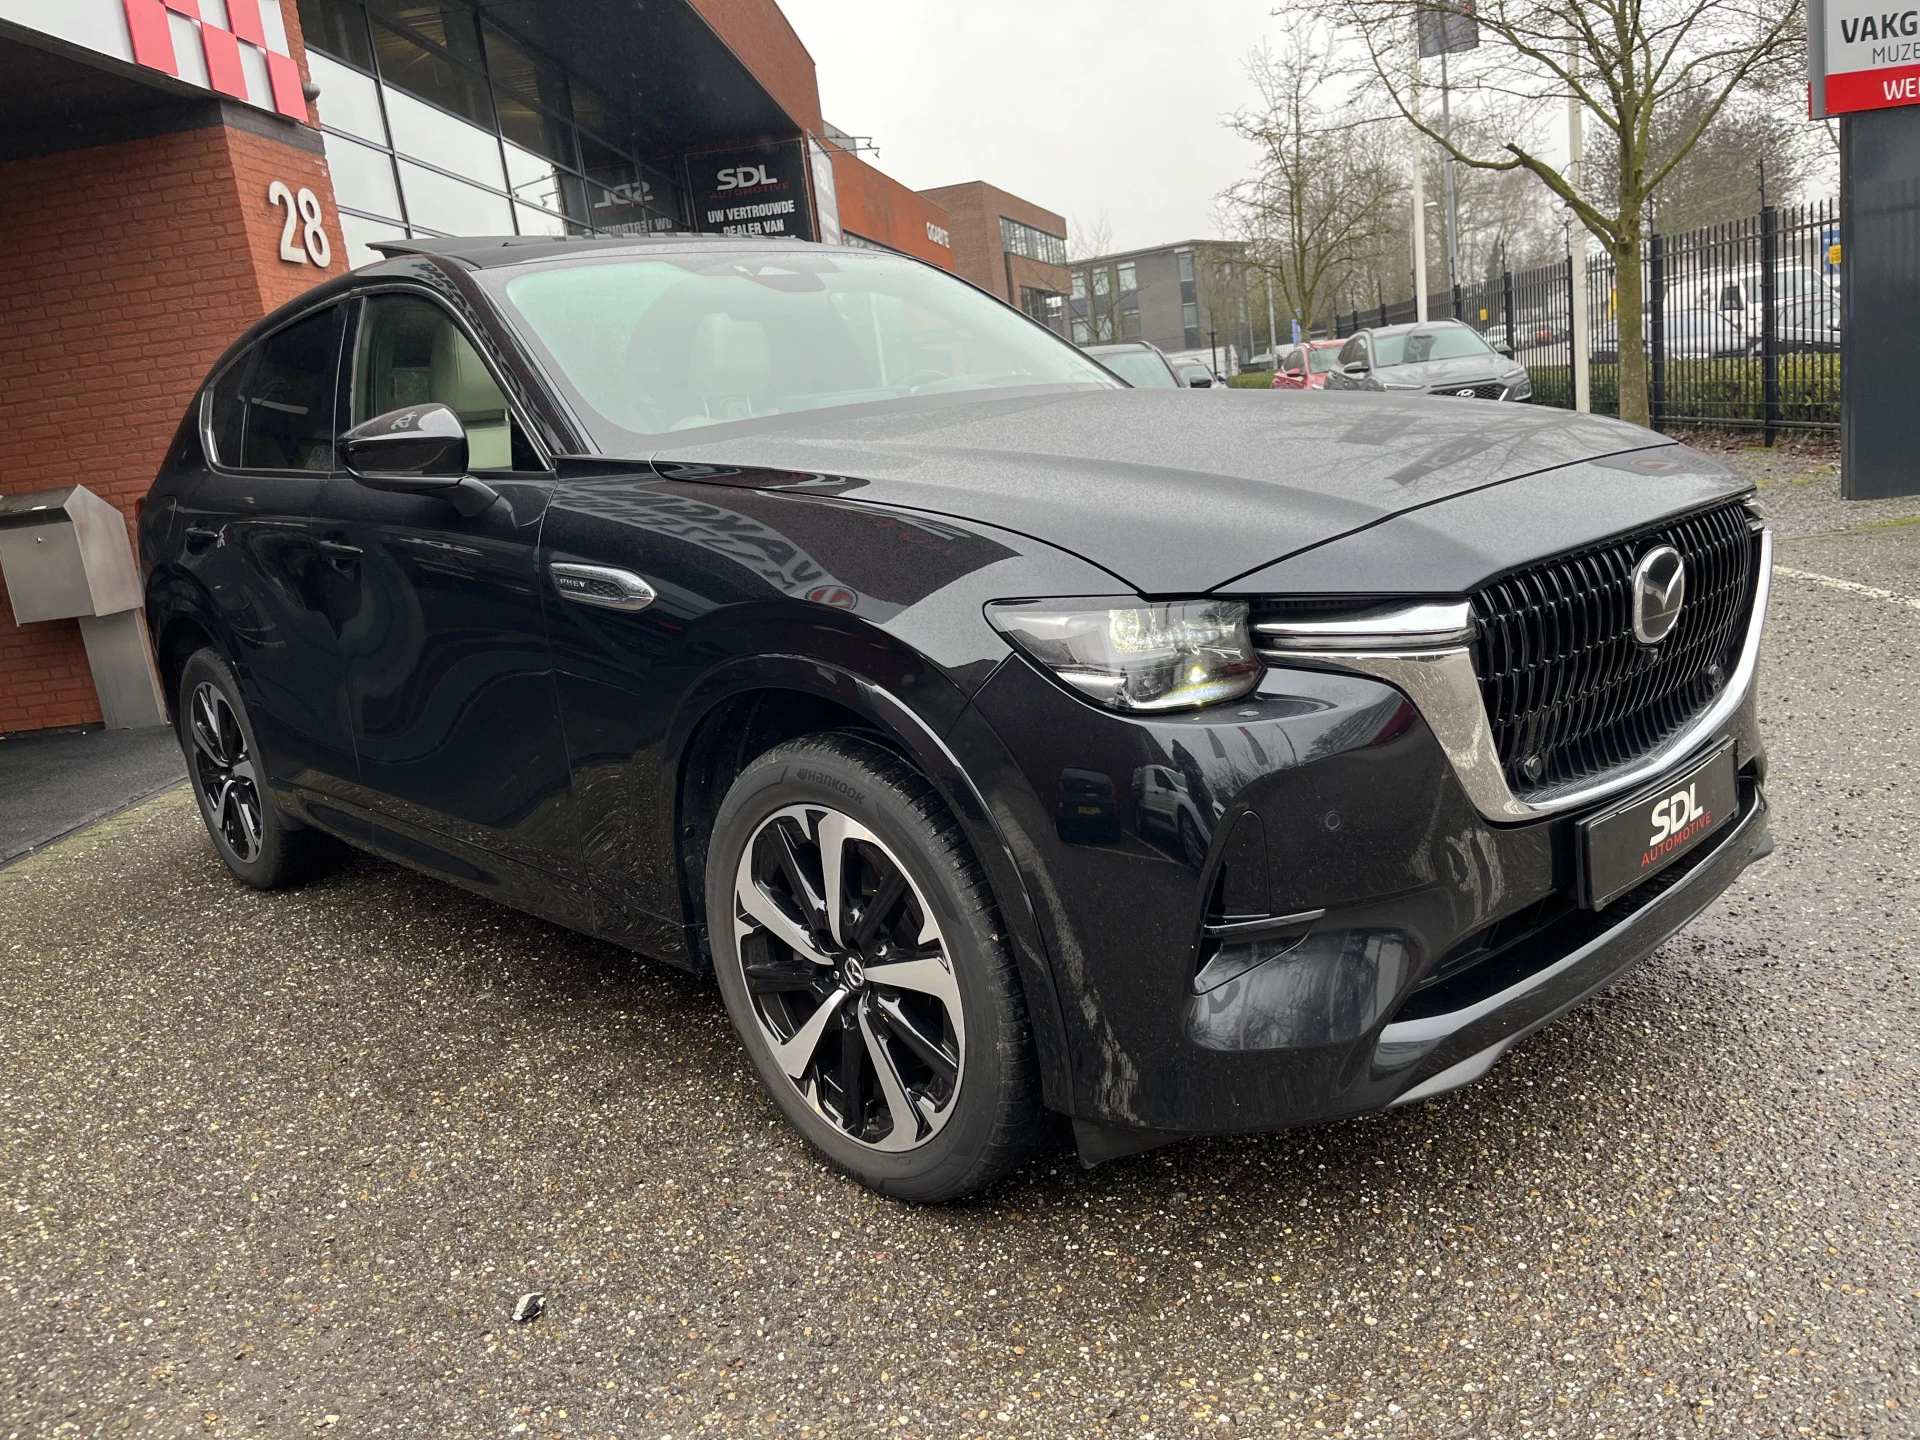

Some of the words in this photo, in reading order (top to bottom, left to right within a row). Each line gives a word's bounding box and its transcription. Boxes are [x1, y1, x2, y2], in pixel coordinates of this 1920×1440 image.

[1841, 10, 1918, 44] VAKG
[1882, 76, 1920, 101] WE
[710, 181, 790, 199] AUTOMOTIVE
[717, 164, 778, 191] SDL
[268, 180, 331, 268] 28
[707, 209, 725, 223] UW
[726, 200, 796, 221] VERTROUWDE
[723, 221, 762, 236] DEALER
[763, 218, 785, 234] VAN
[559, 578, 586, 588] PHEV
[1649, 782, 1704, 847] SDL
[1641, 810, 1712, 868] AUTOMOTIVE
